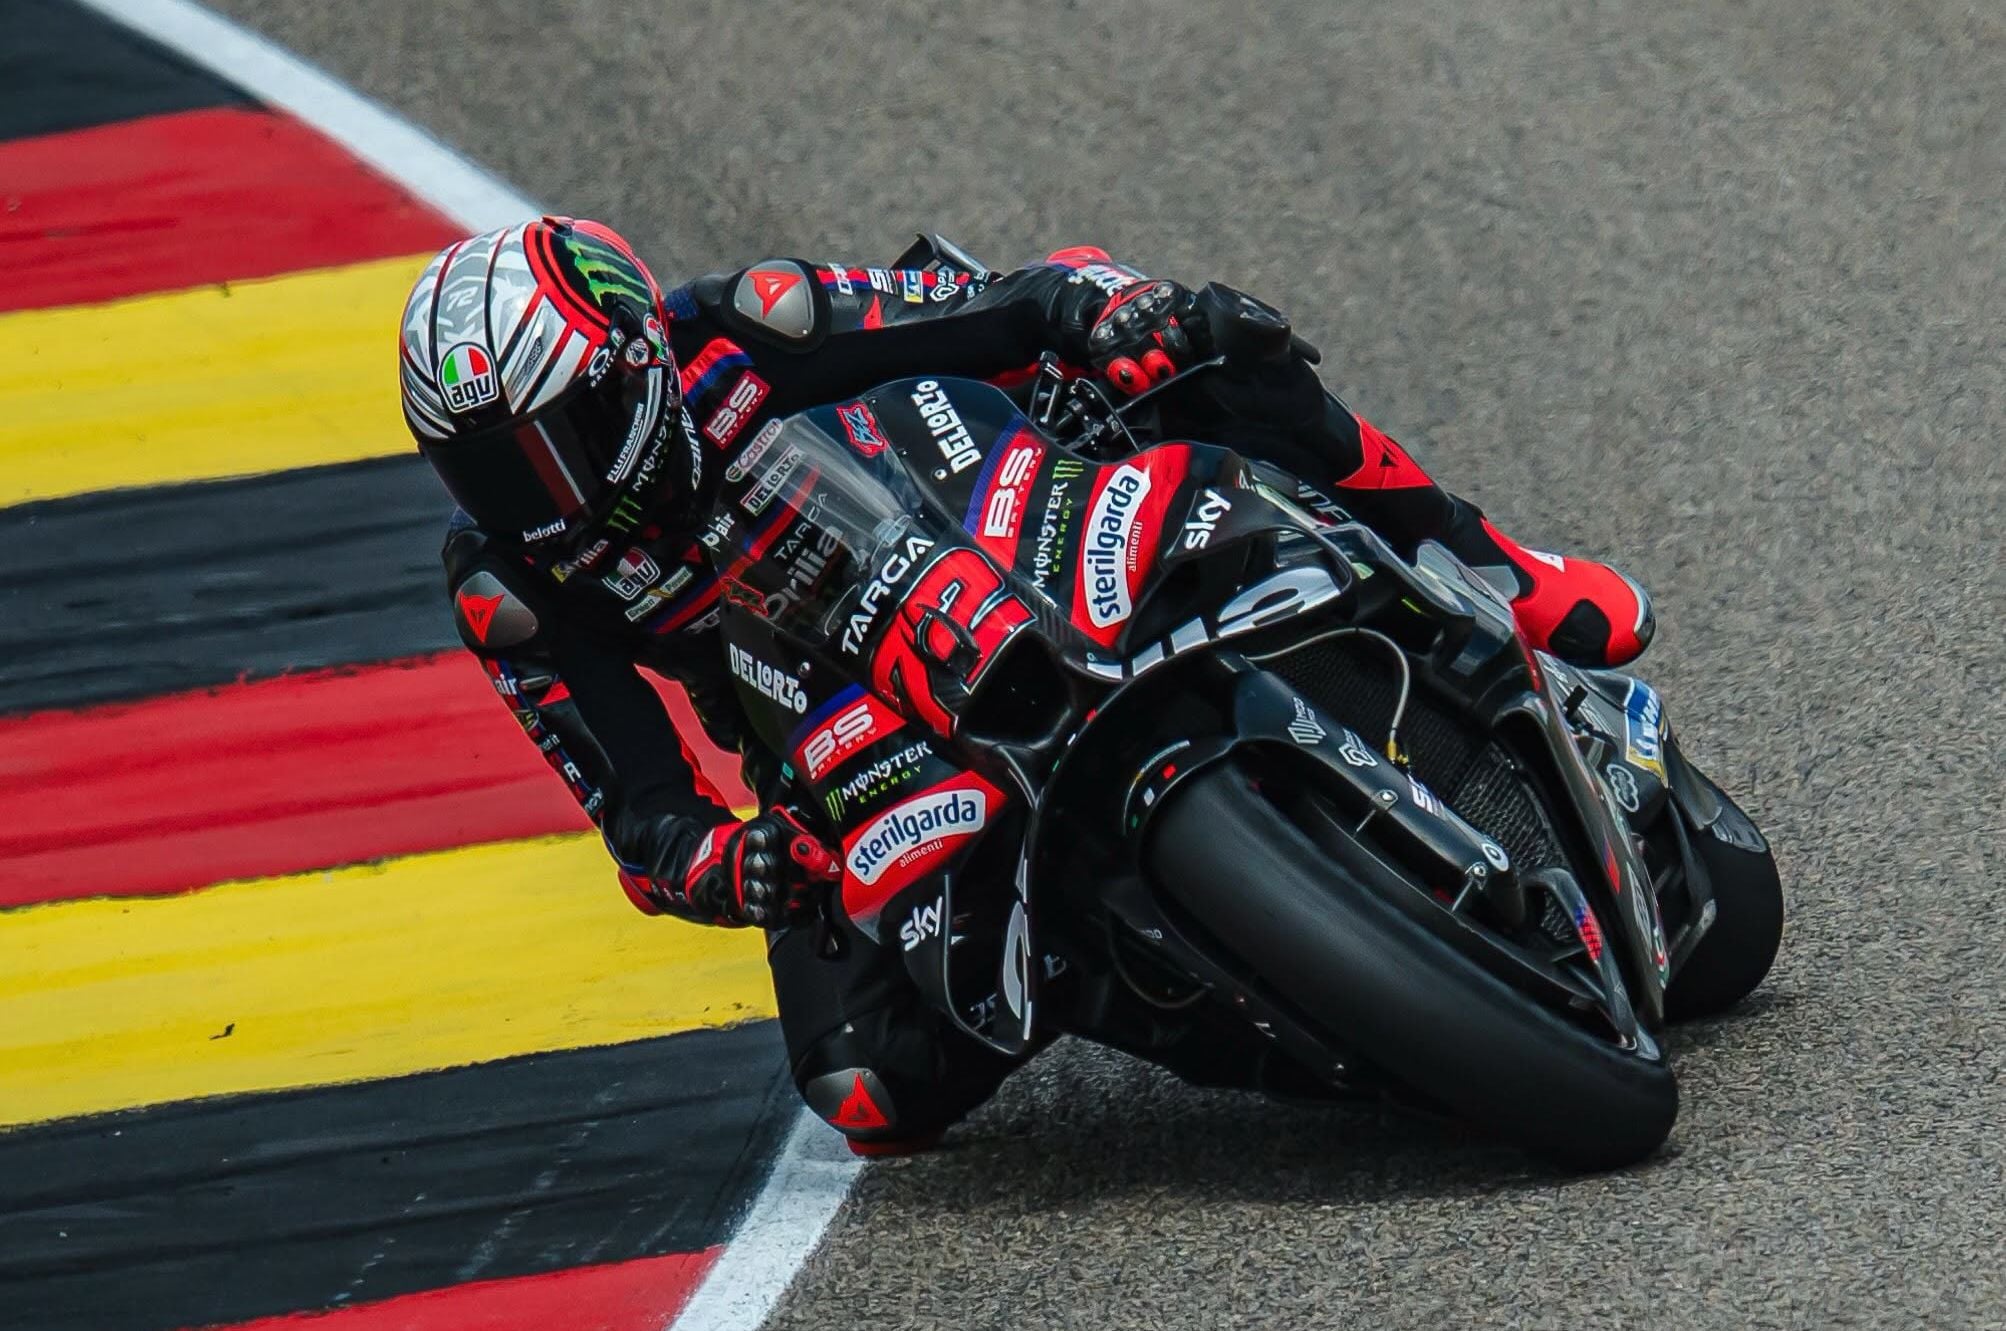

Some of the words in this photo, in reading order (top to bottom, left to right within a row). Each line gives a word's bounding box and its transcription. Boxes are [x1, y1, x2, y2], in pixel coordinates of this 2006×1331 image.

[451, 374, 492, 406] agv
[708, 377, 759, 440] BS
[911, 379, 984, 474] DELLORTO
[983, 446, 1035, 540] BS
[1185, 488, 1232, 551] sky
[523, 518, 567, 543] belotti
[1032, 481, 1069, 589] MONSTER
[1097, 473, 1141, 625] sterilgarda
[1126, 520, 1144, 573] alimenti
[841, 537, 935, 656] TARGA
[729, 643, 808, 715] DELLORTO
[804, 703, 874, 774] BS
[842, 740, 933, 801] MONSTER
[853, 793, 977, 876] sterilgarda
[899, 838, 944, 868] alimenti
[900, 896, 943, 951] sky
